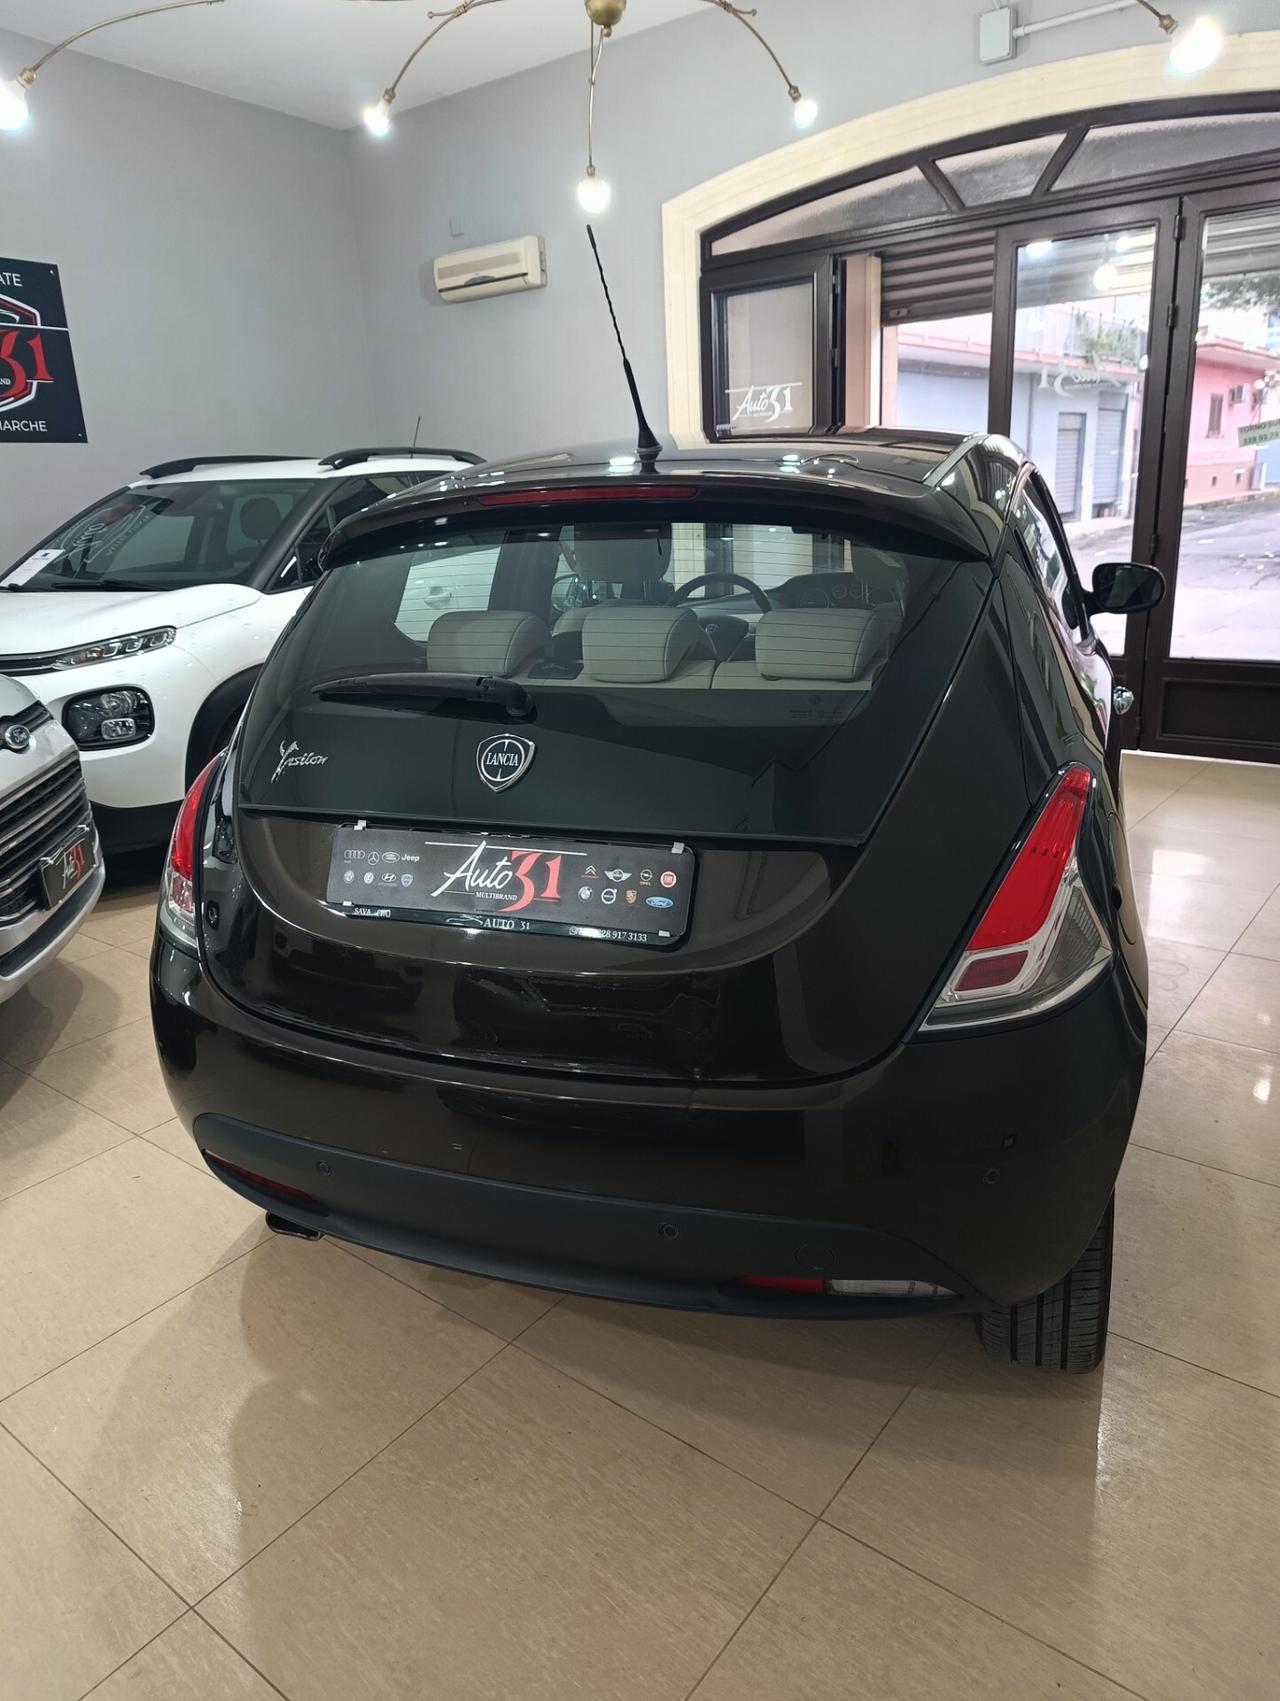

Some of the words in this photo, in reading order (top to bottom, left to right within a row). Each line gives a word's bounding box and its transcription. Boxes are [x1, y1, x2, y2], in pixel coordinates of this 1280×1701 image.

[732, 384, 769, 421] Auto
[765, 385, 793, 423] 31
[0, 420, 47, 432] ARCHE
[485, 752, 519, 766] LANCIA
[401, 853, 420, 862] Jeep
[430, 840, 513, 897] Auto
[498, 850, 562, 912] 31
[475, 891, 518, 901] MULTIBRAND
[483, 918, 515, 930] AUTO
[520, 921, 531, 931] 31
[612, 931, 627, 939] 917
[628, 932, 648, 942] 3133
